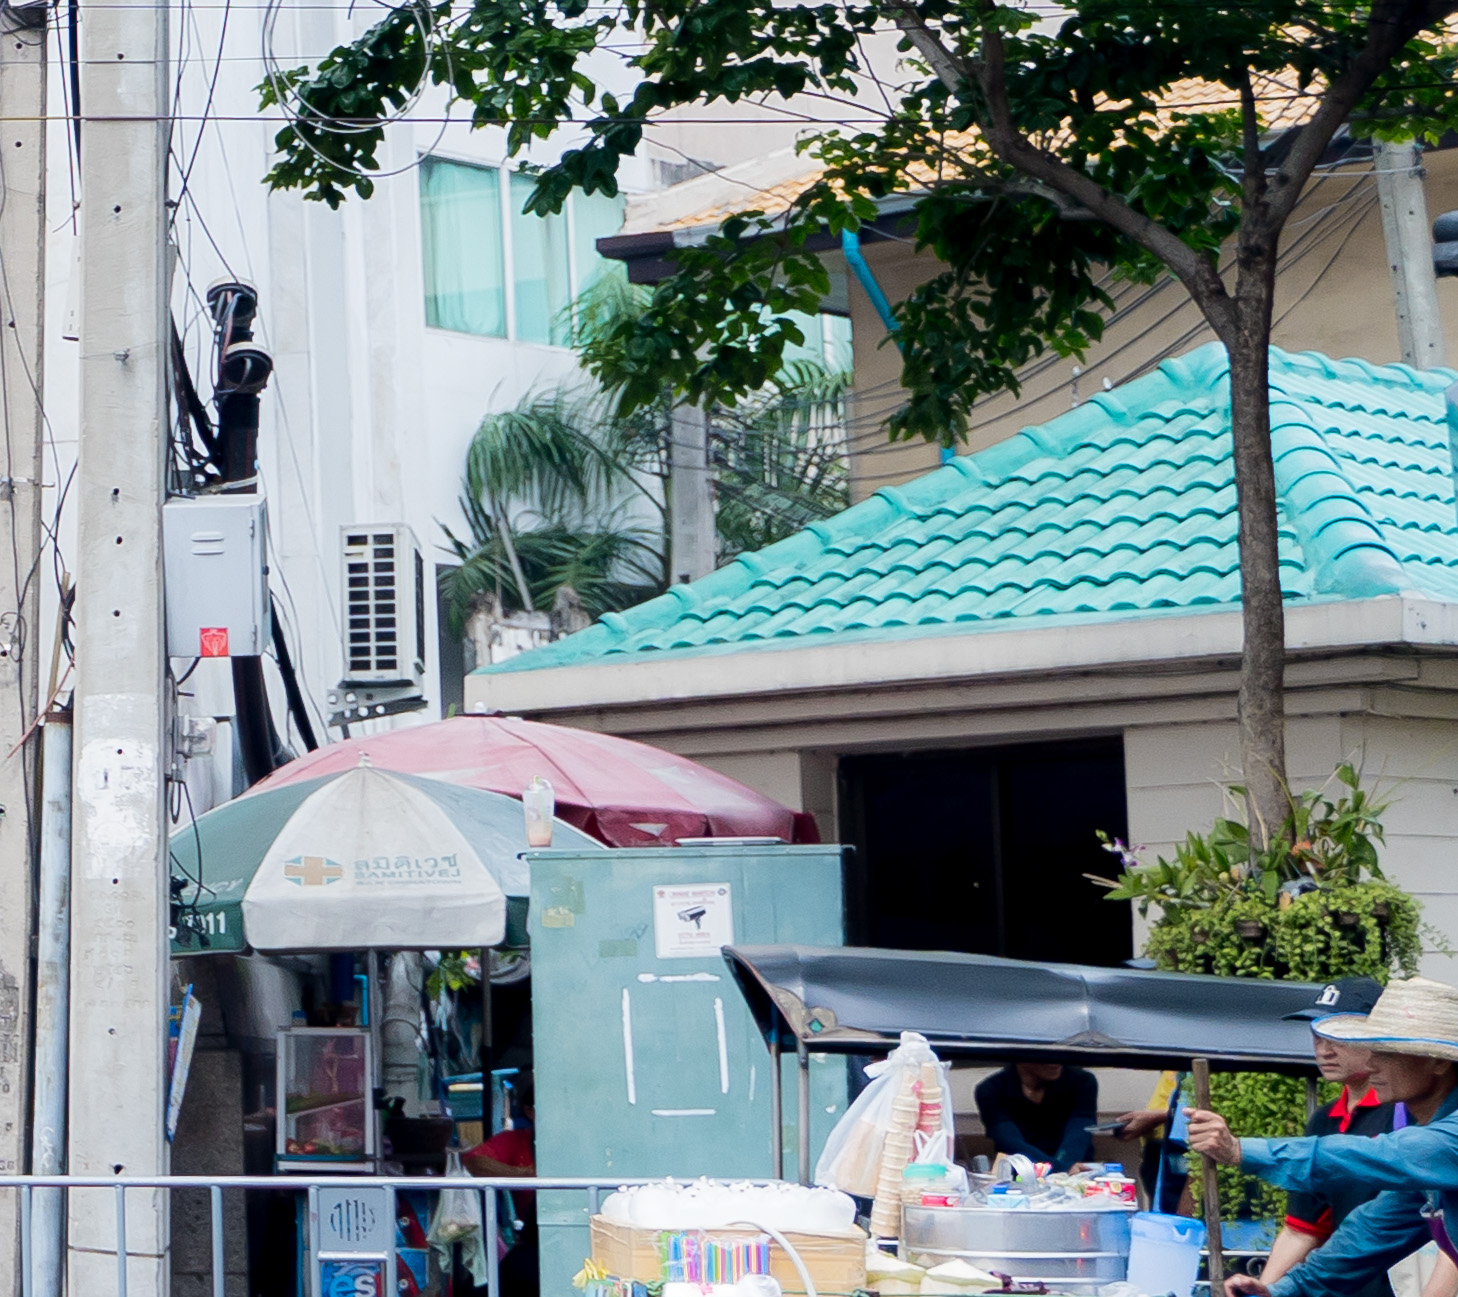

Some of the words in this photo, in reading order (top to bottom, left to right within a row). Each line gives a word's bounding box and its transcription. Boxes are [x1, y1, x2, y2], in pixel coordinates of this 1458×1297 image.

[354, 853, 458, 871] สมิติเวช
[354, 868, 461, 879] SAMITIVEJ
